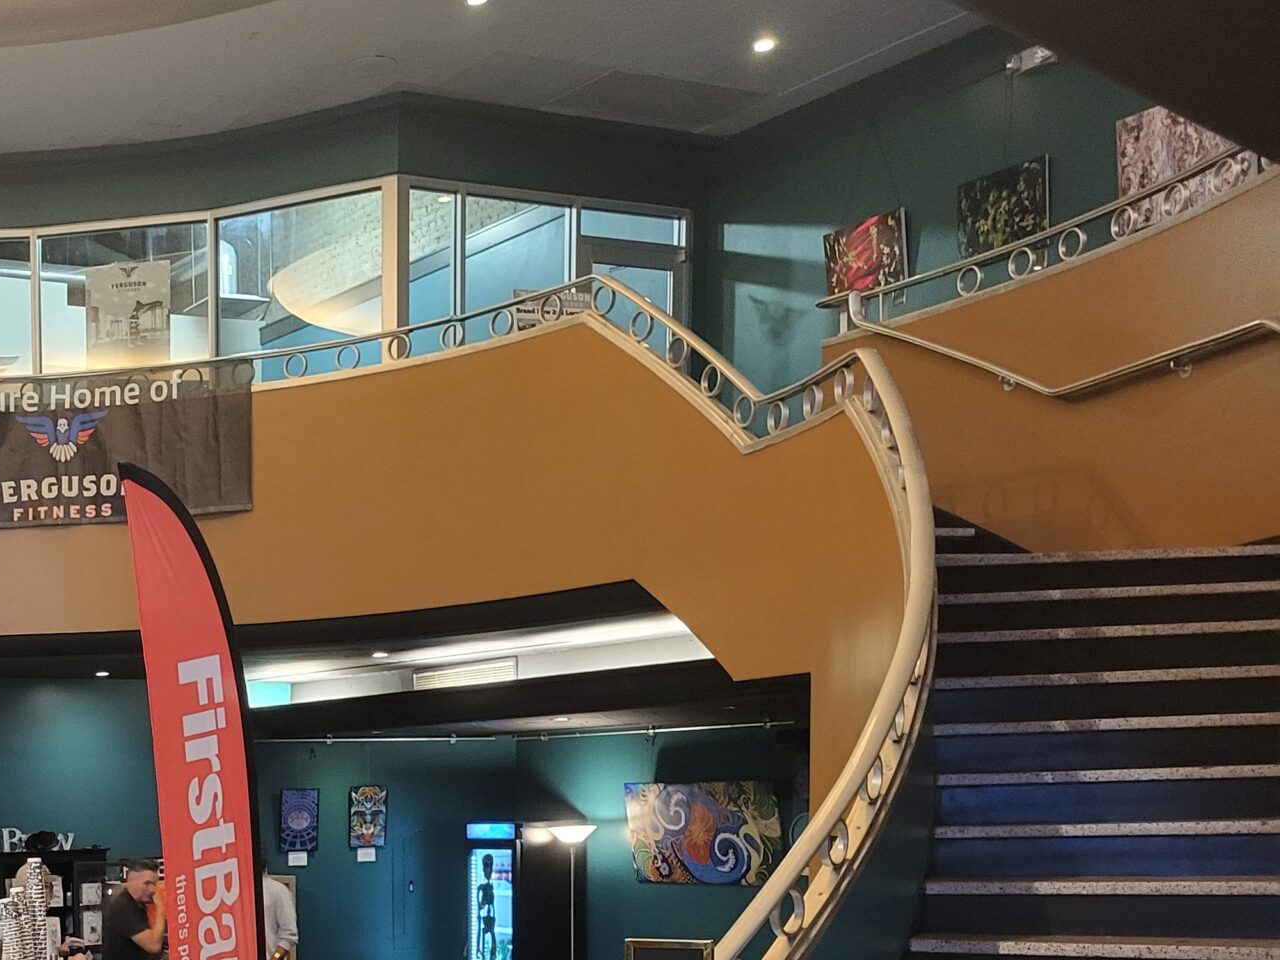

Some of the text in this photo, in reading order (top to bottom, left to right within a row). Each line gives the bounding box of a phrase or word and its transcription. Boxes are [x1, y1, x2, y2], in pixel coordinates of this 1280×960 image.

[111, 281, 146, 290] FERGUSON
[50, 384, 139, 410] Home
[150, 369, 182, 400] of
[13, 503, 112, 521] FITNESS
[175, 873, 190, 940] there's
